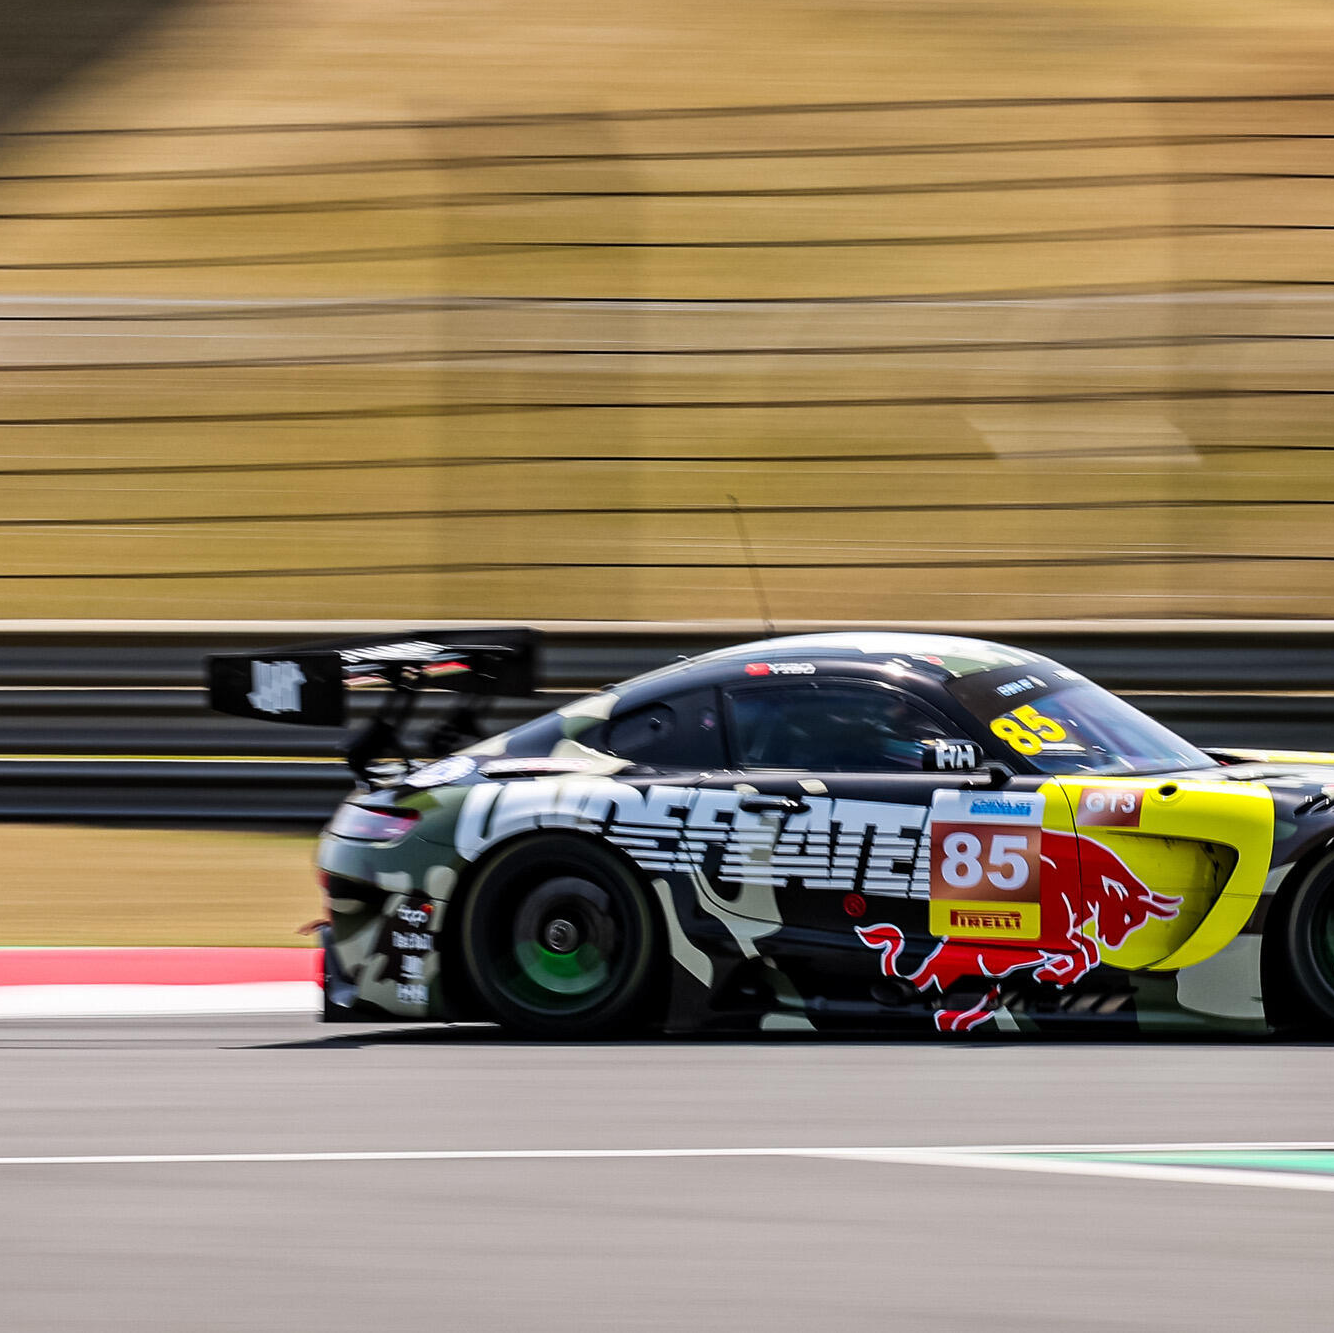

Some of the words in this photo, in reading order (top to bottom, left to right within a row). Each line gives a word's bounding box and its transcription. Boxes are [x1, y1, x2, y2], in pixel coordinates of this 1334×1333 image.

[989, 704, 1067, 756] 85
[1084, 791, 1136, 814] GT3
[940, 831, 1030, 891] 85
[950, 909, 1022, 929] PIRELLI
